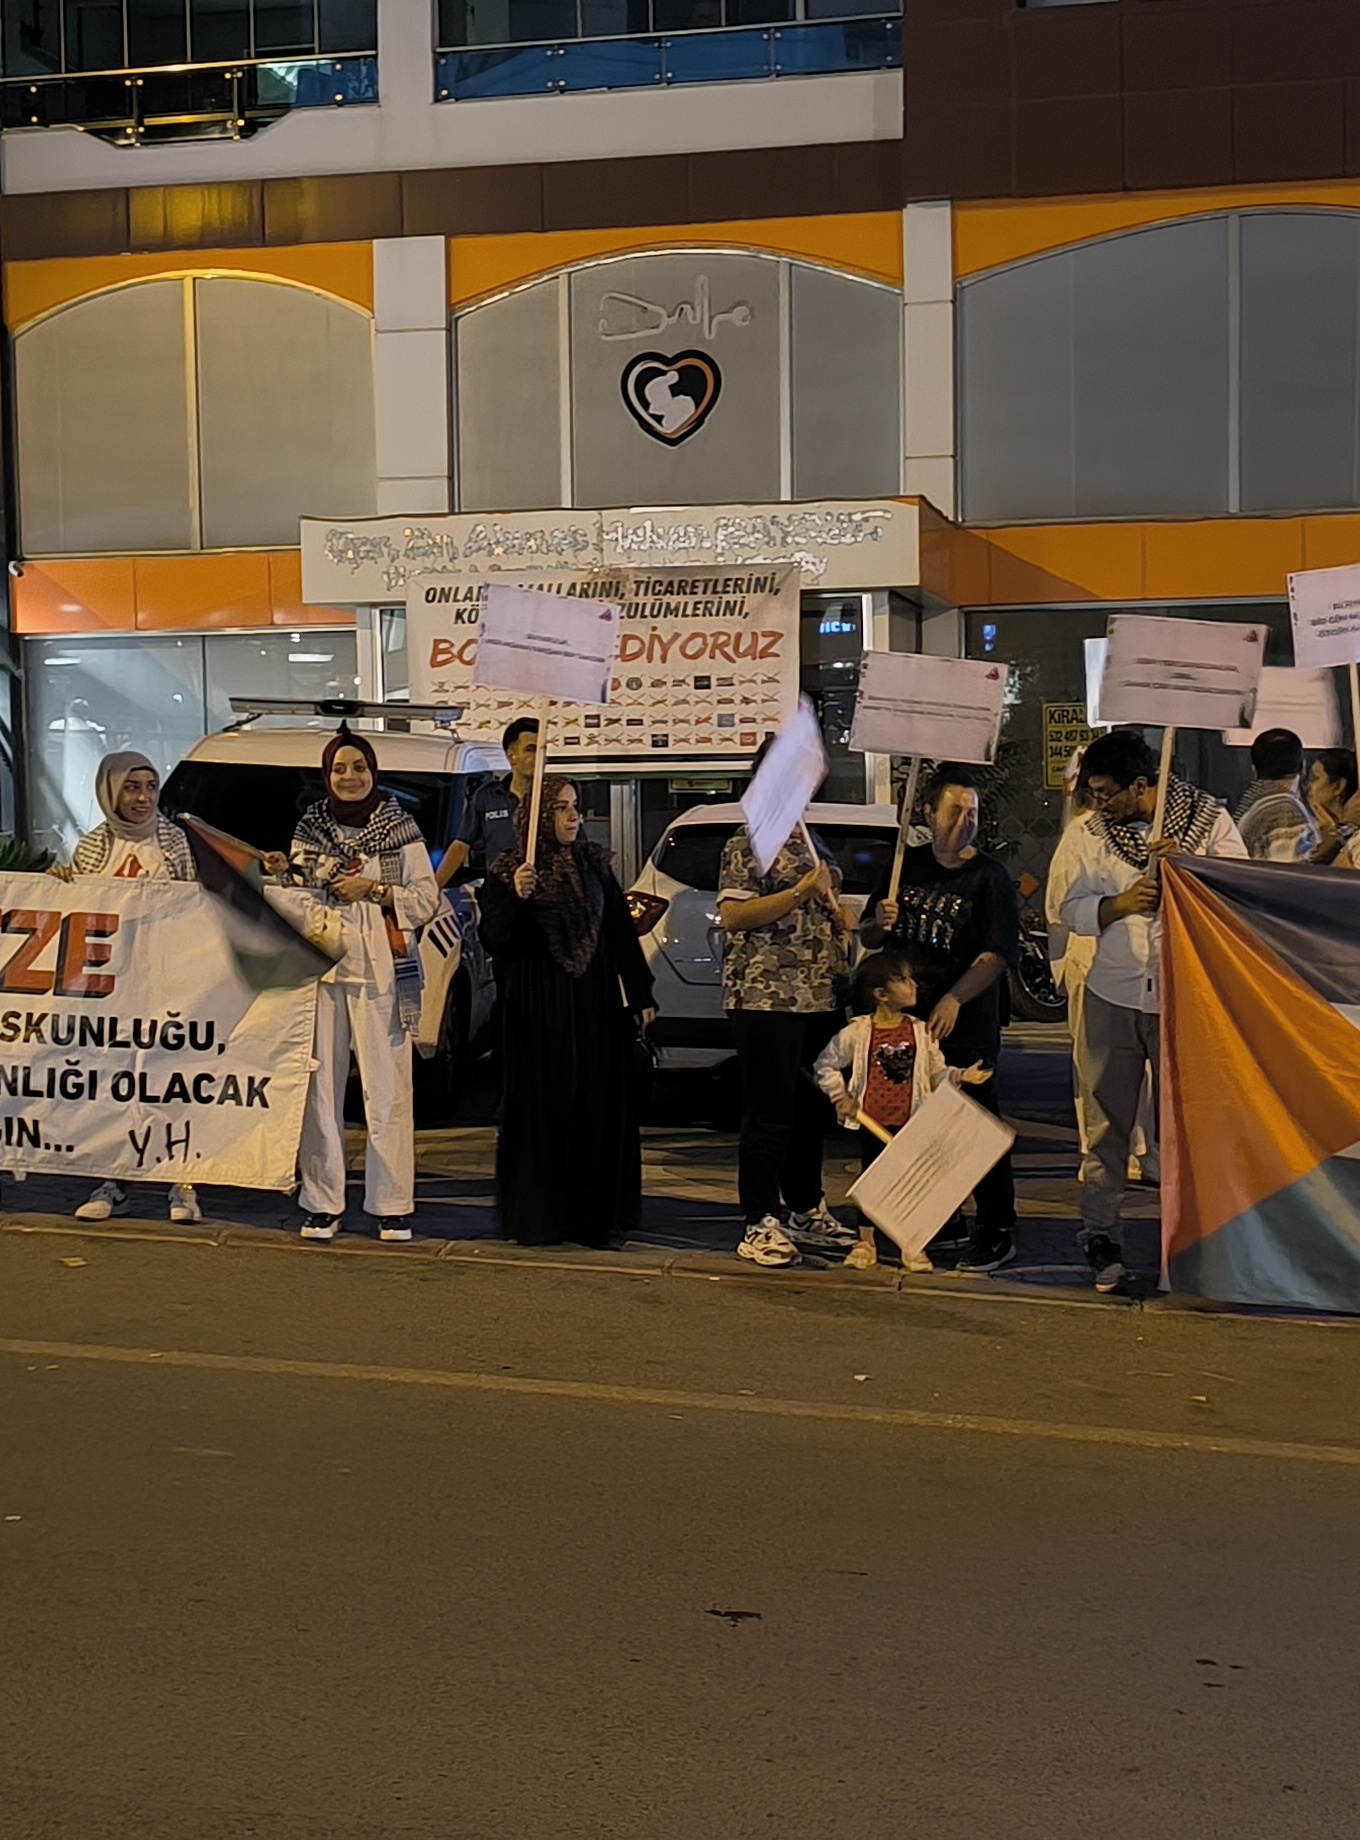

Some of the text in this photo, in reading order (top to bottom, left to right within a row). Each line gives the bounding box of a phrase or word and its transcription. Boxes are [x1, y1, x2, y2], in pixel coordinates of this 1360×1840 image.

[633, 572, 781, 597] TİCARETLERİNİ,
[617, 625, 785, 664] DİYORUZ
[110, 1070, 272, 1109] OLACAK
